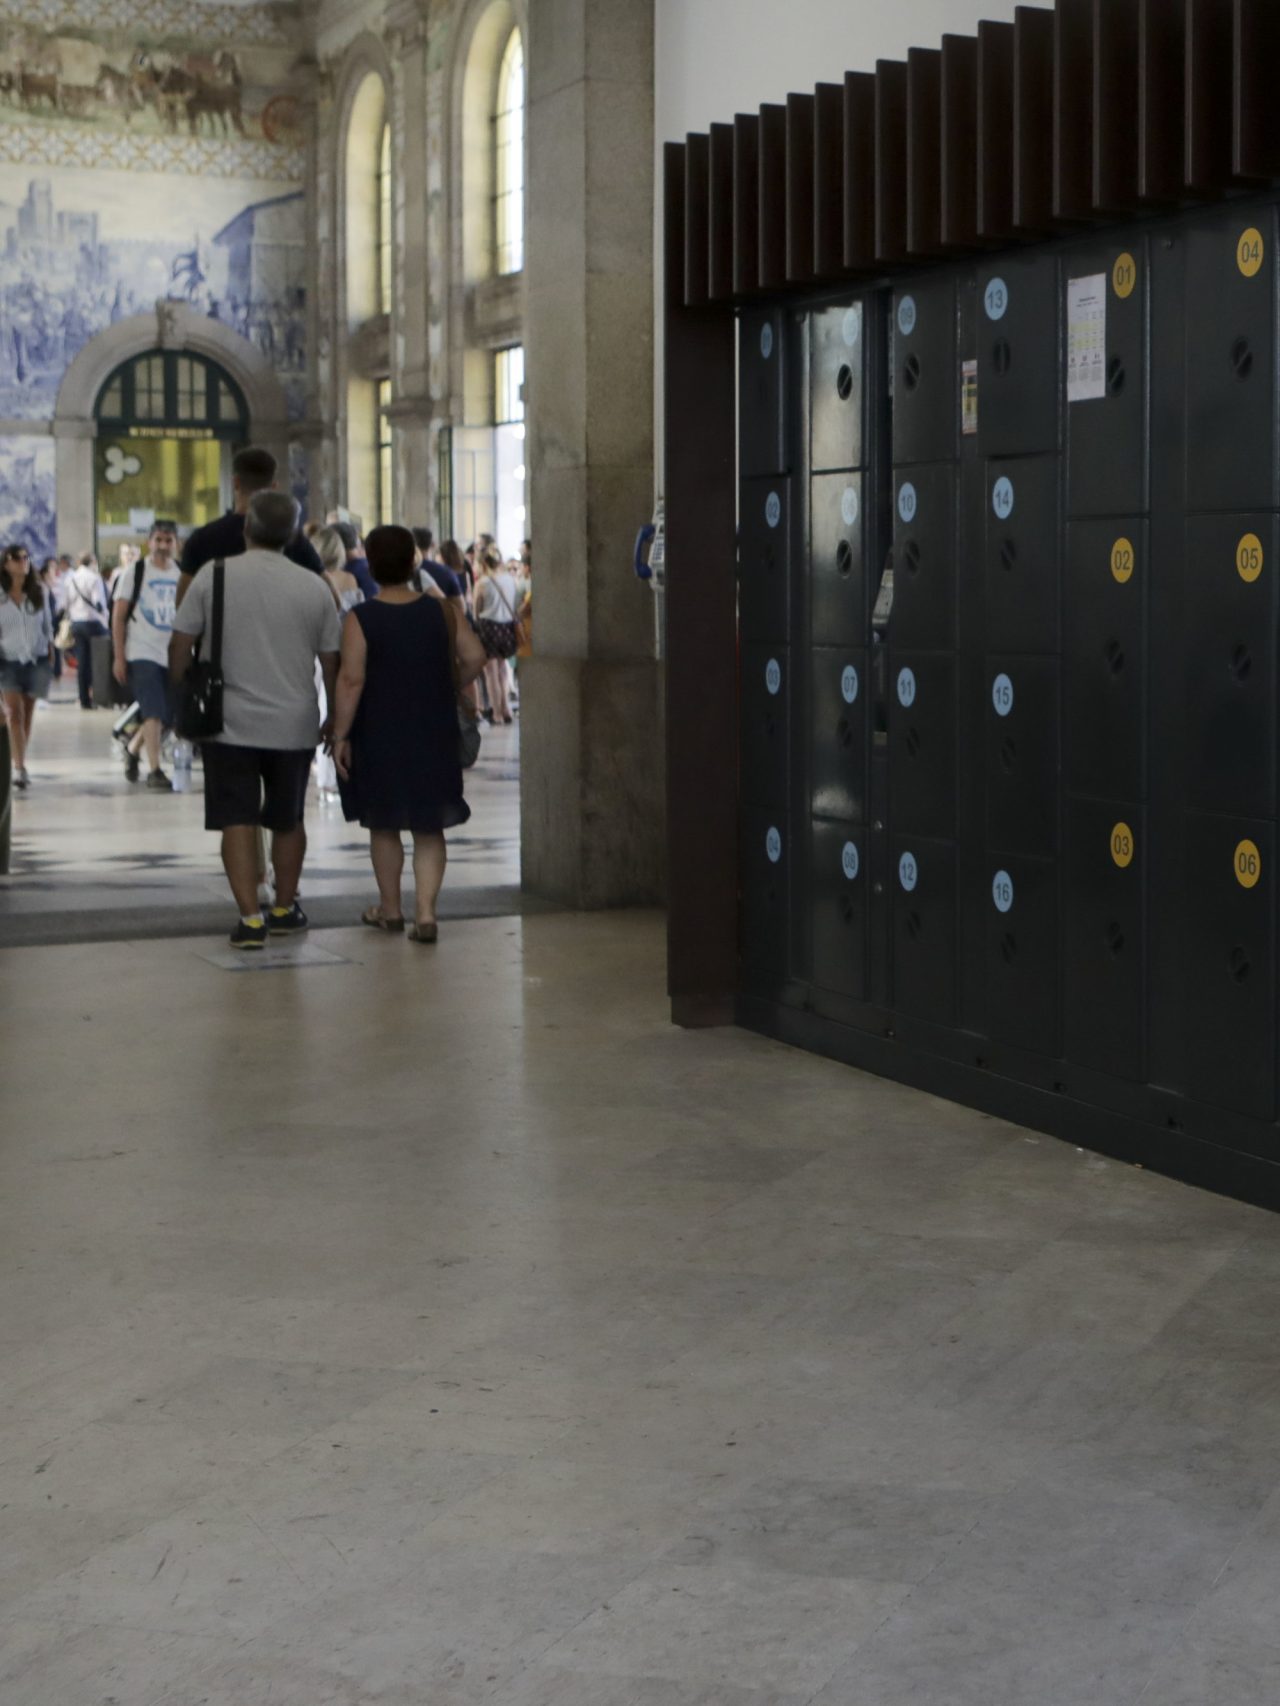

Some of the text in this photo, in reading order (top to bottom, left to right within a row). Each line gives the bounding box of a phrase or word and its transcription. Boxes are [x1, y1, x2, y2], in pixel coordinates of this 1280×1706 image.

[1241, 240, 1259, 263] 04
[1116, 264, 1131, 286] 01
[987, 289, 1003, 310] 13
[901, 494, 913, 512] 10
[995, 489, 1009, 509] 14
[1114, 550, 1130, 570] 02
[1240, 548, 1258, 570] 05
[844, 676, 856, 694] 07
[901, 679, 912, 697] 11
[996, 686, 1009, 706] 15
[1114, 834, 1129, 857] 03
[902, 862, 914, 881] 12
[1239, 852, 1256, 876] 06
[996, 882, 1009, 902] 16
